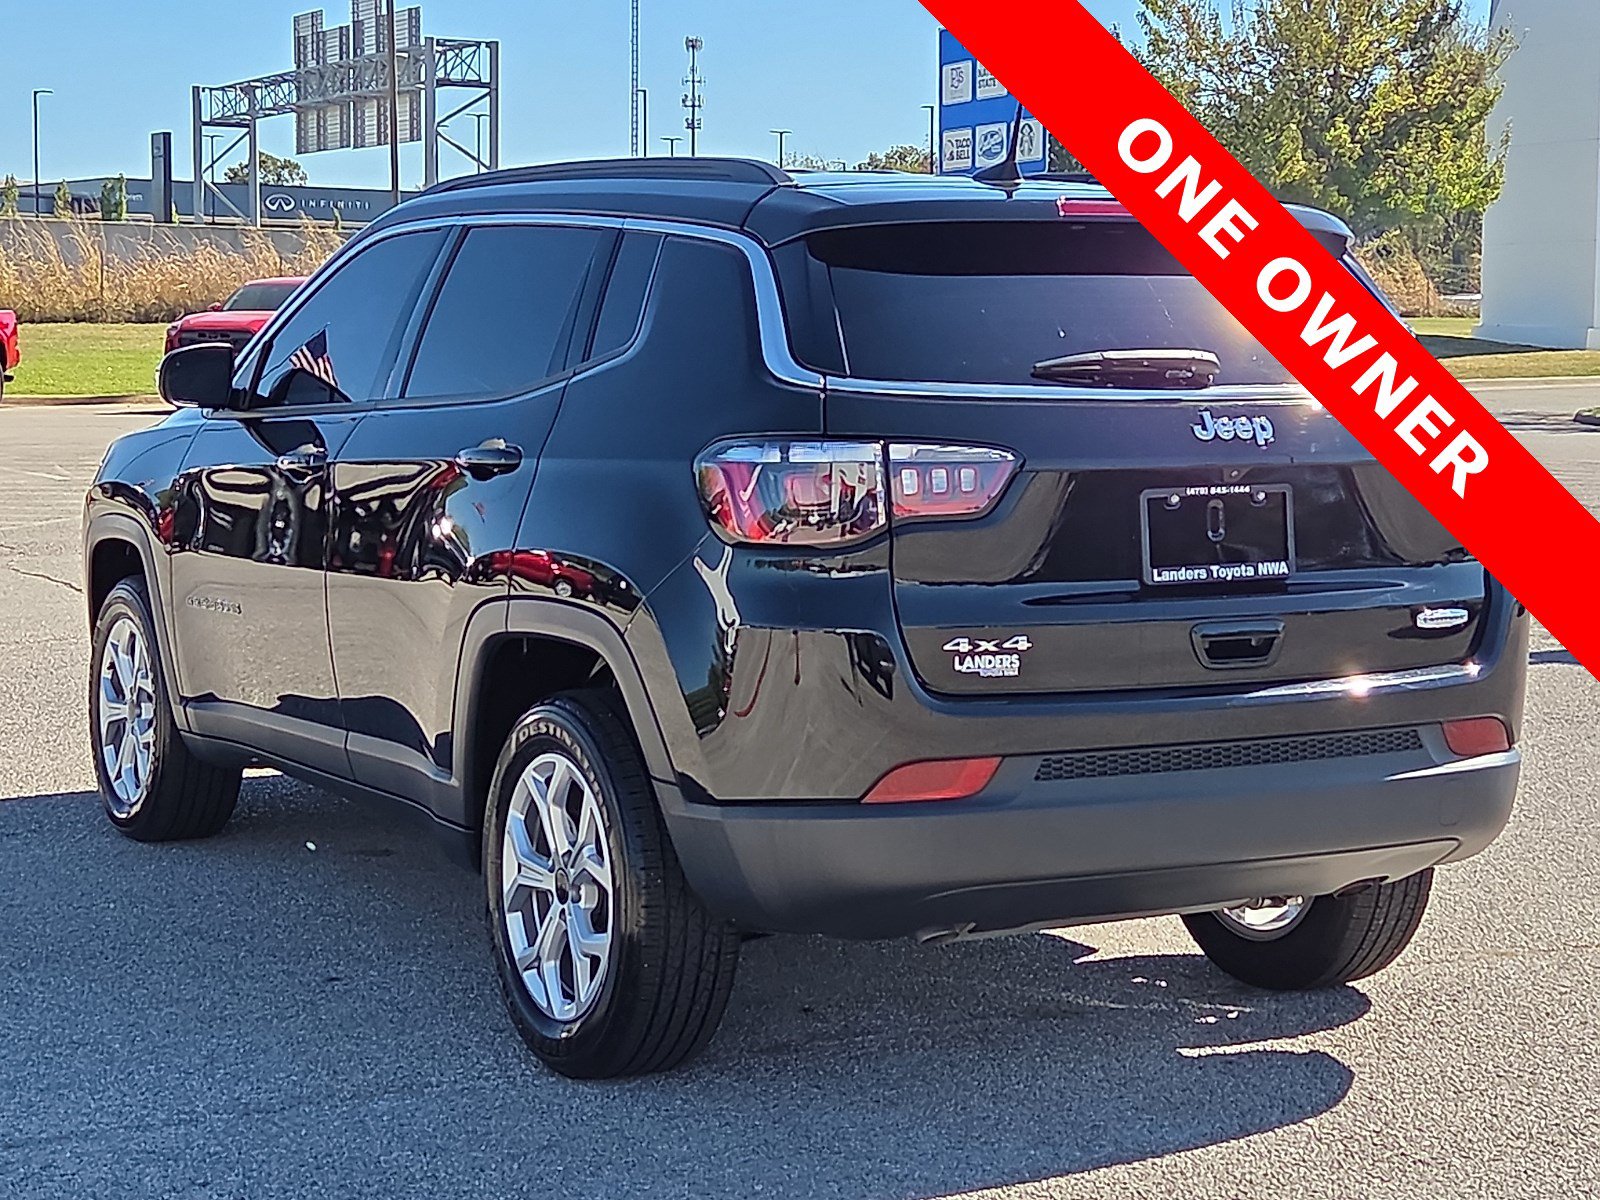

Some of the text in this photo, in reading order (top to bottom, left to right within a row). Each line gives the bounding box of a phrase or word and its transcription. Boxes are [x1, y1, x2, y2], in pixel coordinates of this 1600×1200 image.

[955, 137, 972, 148] TACO
[955, 149, 971, 160] BELL
[301, 199, 371, 210] INFINITI
[1191, 410, 1274, 446] Jeep
[1153, 561, 1289, 582] Landers Toyota NWA
[954, 654, 1020, 672] LANDERS
